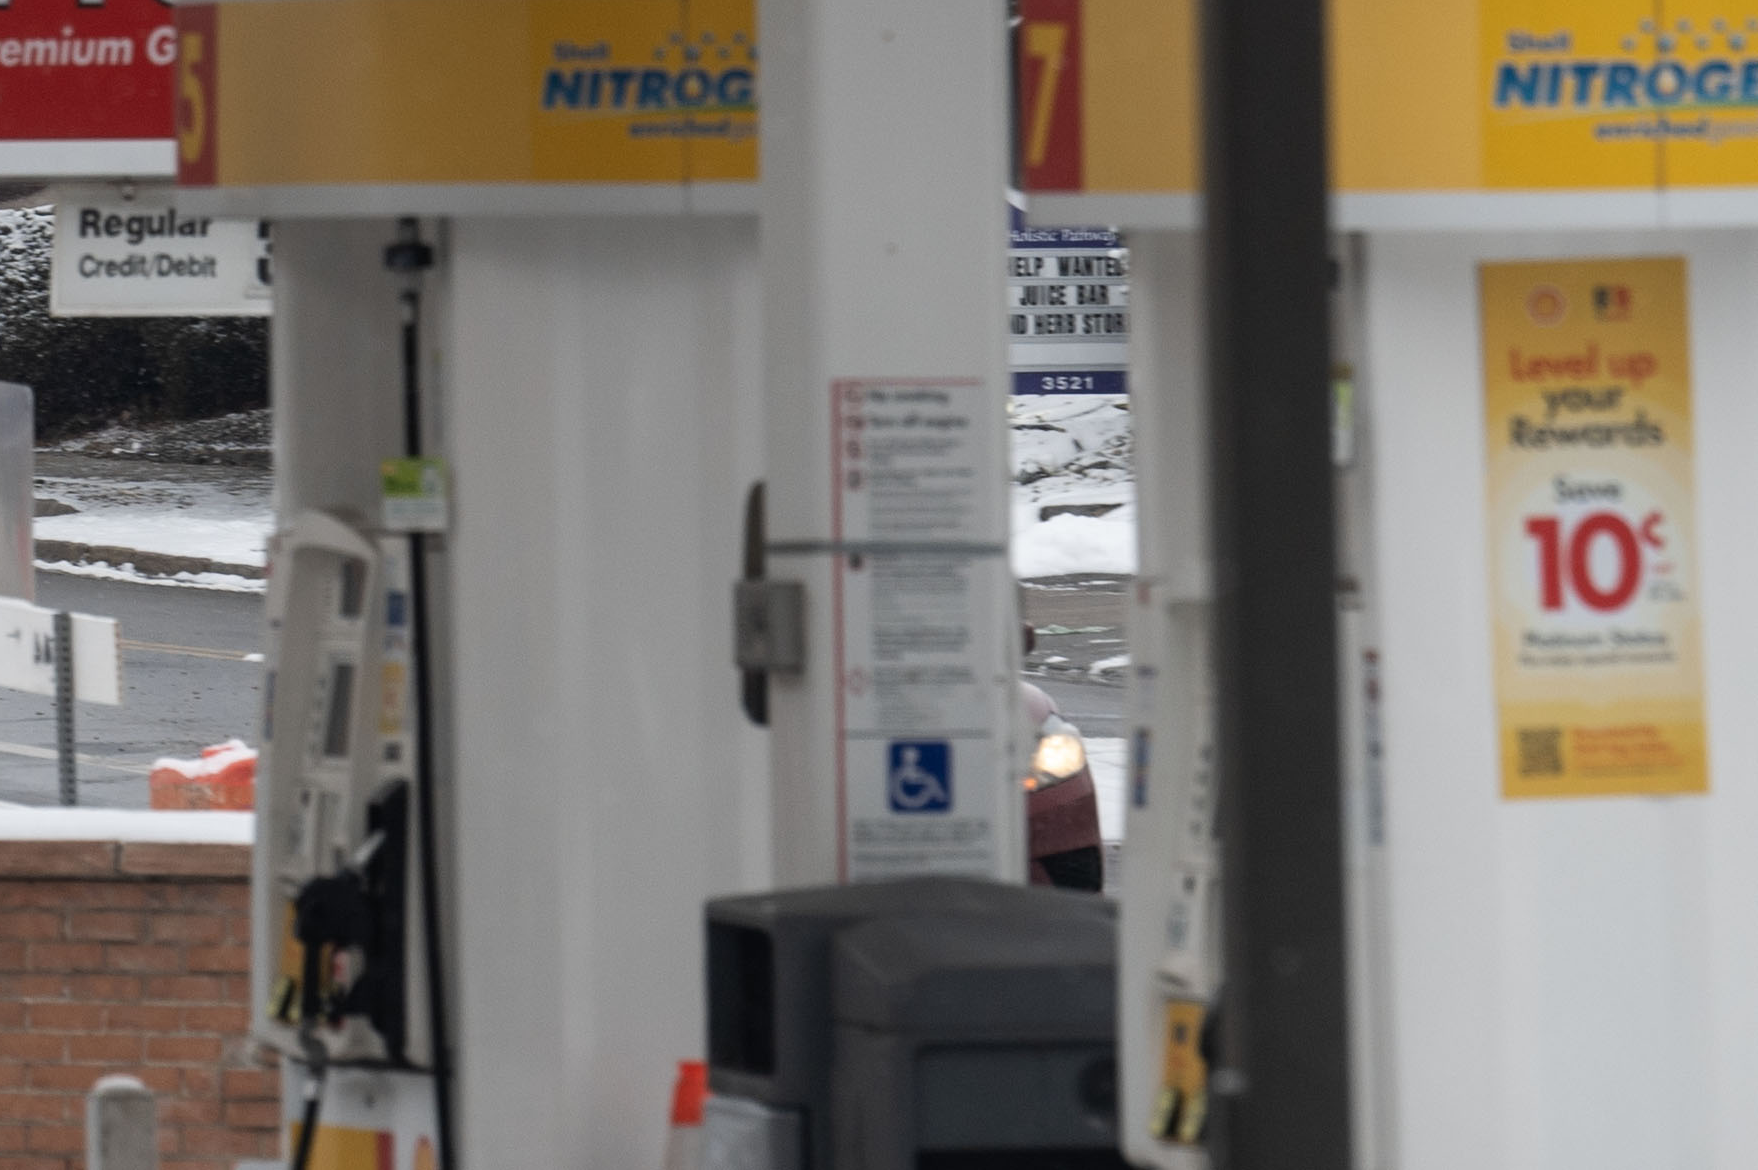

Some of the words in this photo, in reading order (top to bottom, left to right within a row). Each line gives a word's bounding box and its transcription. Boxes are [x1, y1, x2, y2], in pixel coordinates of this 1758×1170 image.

[180, 31, 206, 165] 5
[543, 68, 755, 109] NITROG
[1026, 23, 1065, 168] 7
[79, 208, 212, 245] Regular
[78, 253, 217, 280] Credit/Debit
[1019, 285, 1067, 306] JUICE
[1077, 285, 1109, 306] BAR
[1034, 314, 1076, 335] HERB
[1083, 313, 1127, 334] STOR
[1042, 376, 1094, 390] 3521
[1509, 341, 1599, 382] Level
[1607, 352, 1659, 389] up
[1543, 386, 1623, 424] your
[1510, 408, 1664, 448] Rewards
